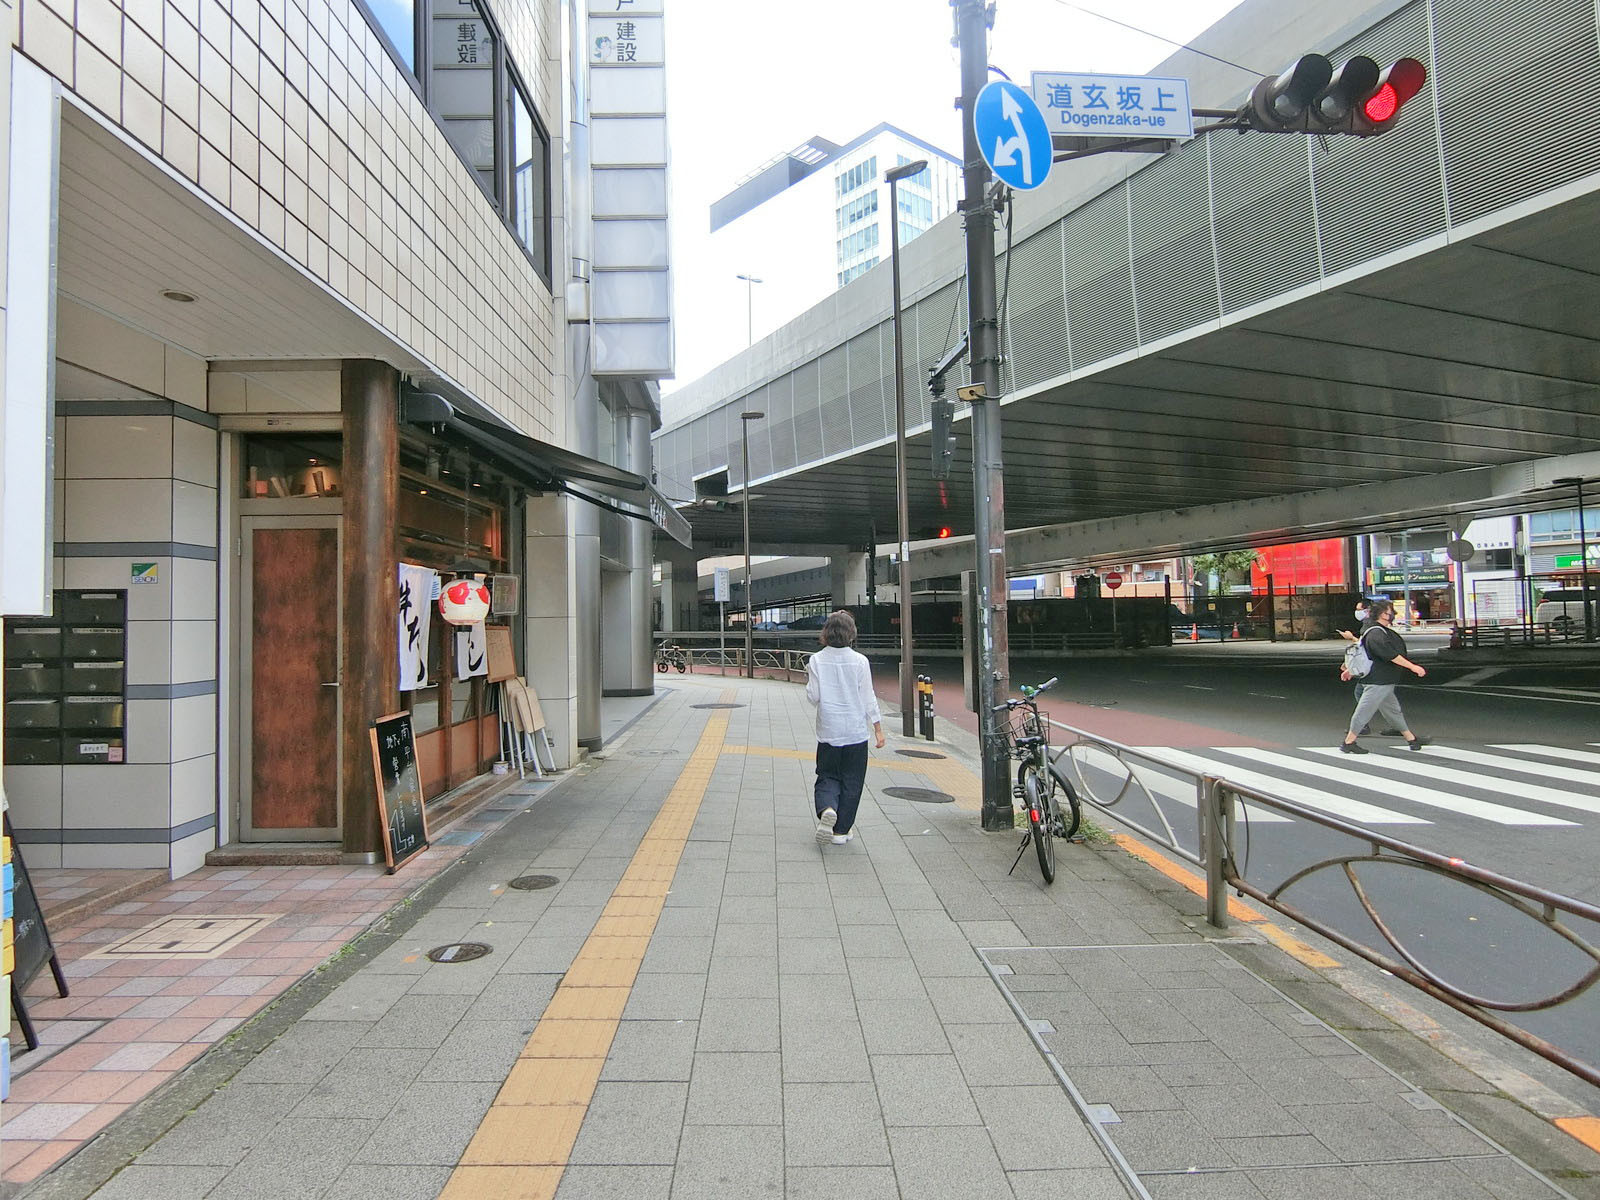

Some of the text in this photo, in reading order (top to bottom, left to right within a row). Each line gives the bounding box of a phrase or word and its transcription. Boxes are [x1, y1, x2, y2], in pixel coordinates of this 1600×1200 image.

[1047, 83, 1177, 112] 道玄坂上
[1061, 110, 1166, 127] Dogenzaka-ue
